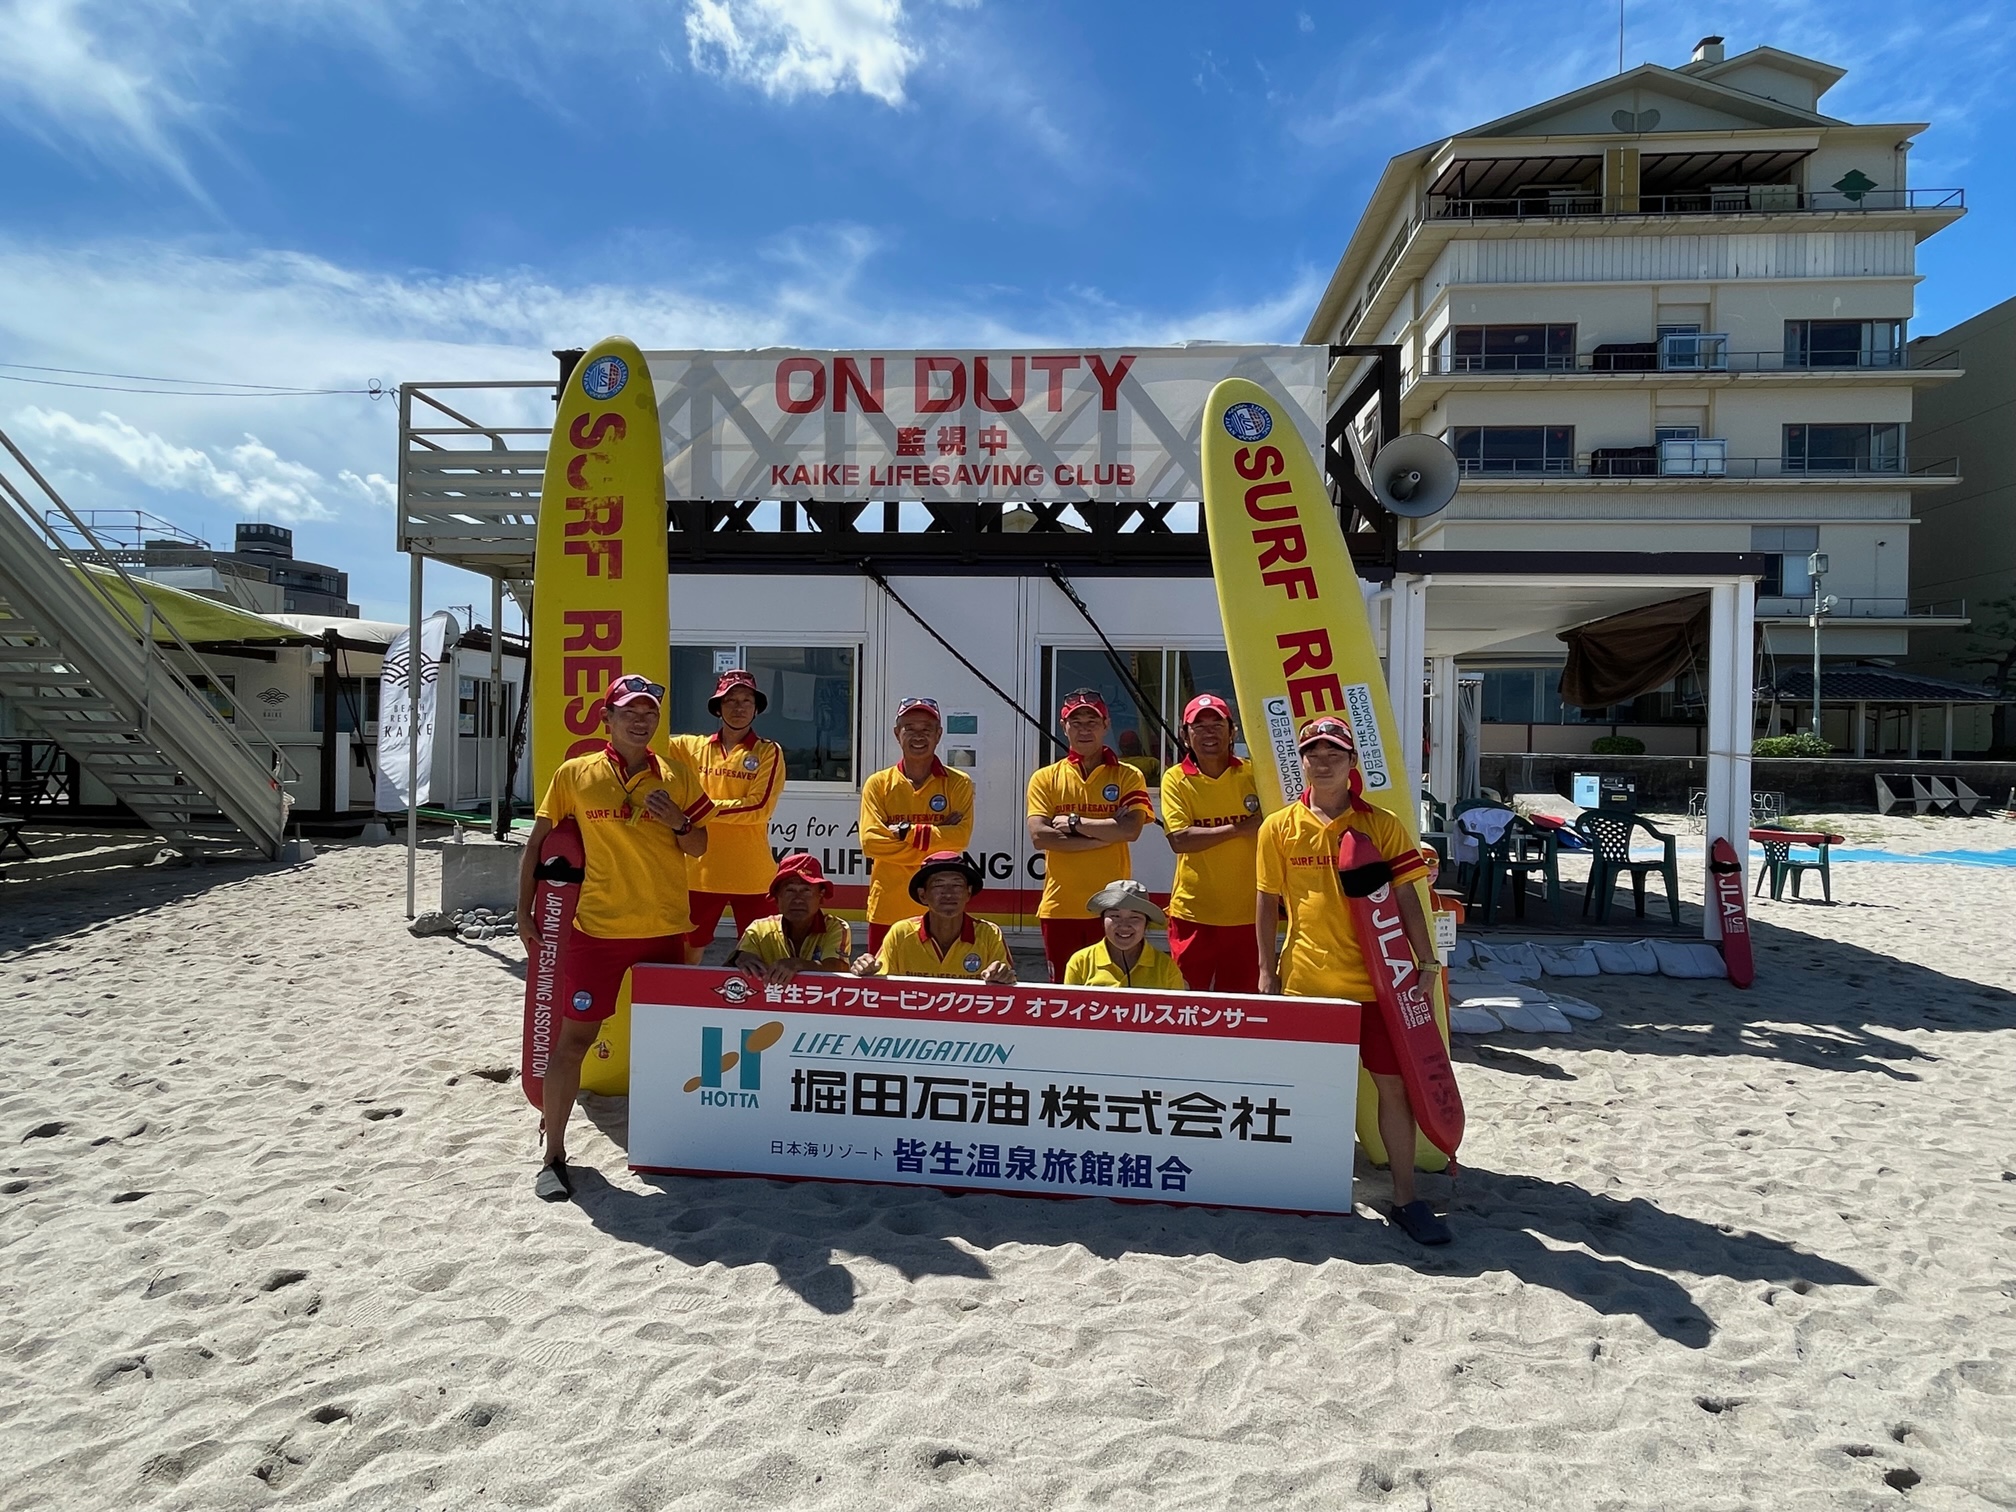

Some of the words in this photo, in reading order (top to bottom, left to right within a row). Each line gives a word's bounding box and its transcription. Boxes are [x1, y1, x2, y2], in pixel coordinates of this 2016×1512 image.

[775, 356, 885, 414] ON
[914, 355, 1138, 414] DUTY
[896, 425, 1008, 457] 監視中
[771, 464, 860, 487] KAIKE
[870, 464, 1044, 487] LIFESAVING
[1054, 464, 1136, 486] CLUB
[1234, 445, 1320, 600] SURF
[1347, 688, 1362, 727] NIPPON
[1358, 686, 1378, 747] FOUNDATION
[1285, 739, 1297, 758] THE
[1357, 730, 1367, 748] THE
[1275, 740, 1296, 801] FOUNDATION
[1290, 758, 1304, 801] NIPPON
[585, 809, 610, 819] SURF
[767, 819, 797, 842] ing
[806, 816, 839, 839] for
[1055, 803, 1076, 813] SURF
[543, 892, 561, 935] JAPAN
[1719, 878, 1742, 916] JLA
[536, 932, 558, 1007] LIFESAVING
[1371, 908, 1415, 989] JLA
[764, 984, 1015, 1016] 皆生ライフセービングクラブ
[1026, 997, 1268, 1028] オフィシャルスポンサー
[532, 1003, 552, 1078] ASSOCIATION
[791, 1032, 852, 1055] LIFE
[855, 1035, 1015, 1065] NAVIGATION
[701, 1090, 760, 1109] HOTTA
[790, 1068, 1293, 1144] 堀田石油株式会社
[770, 1140, 884, 1161] 日本海リゾート
[893, 1137, 1193, 1192] 皆生温泉旅館組合
